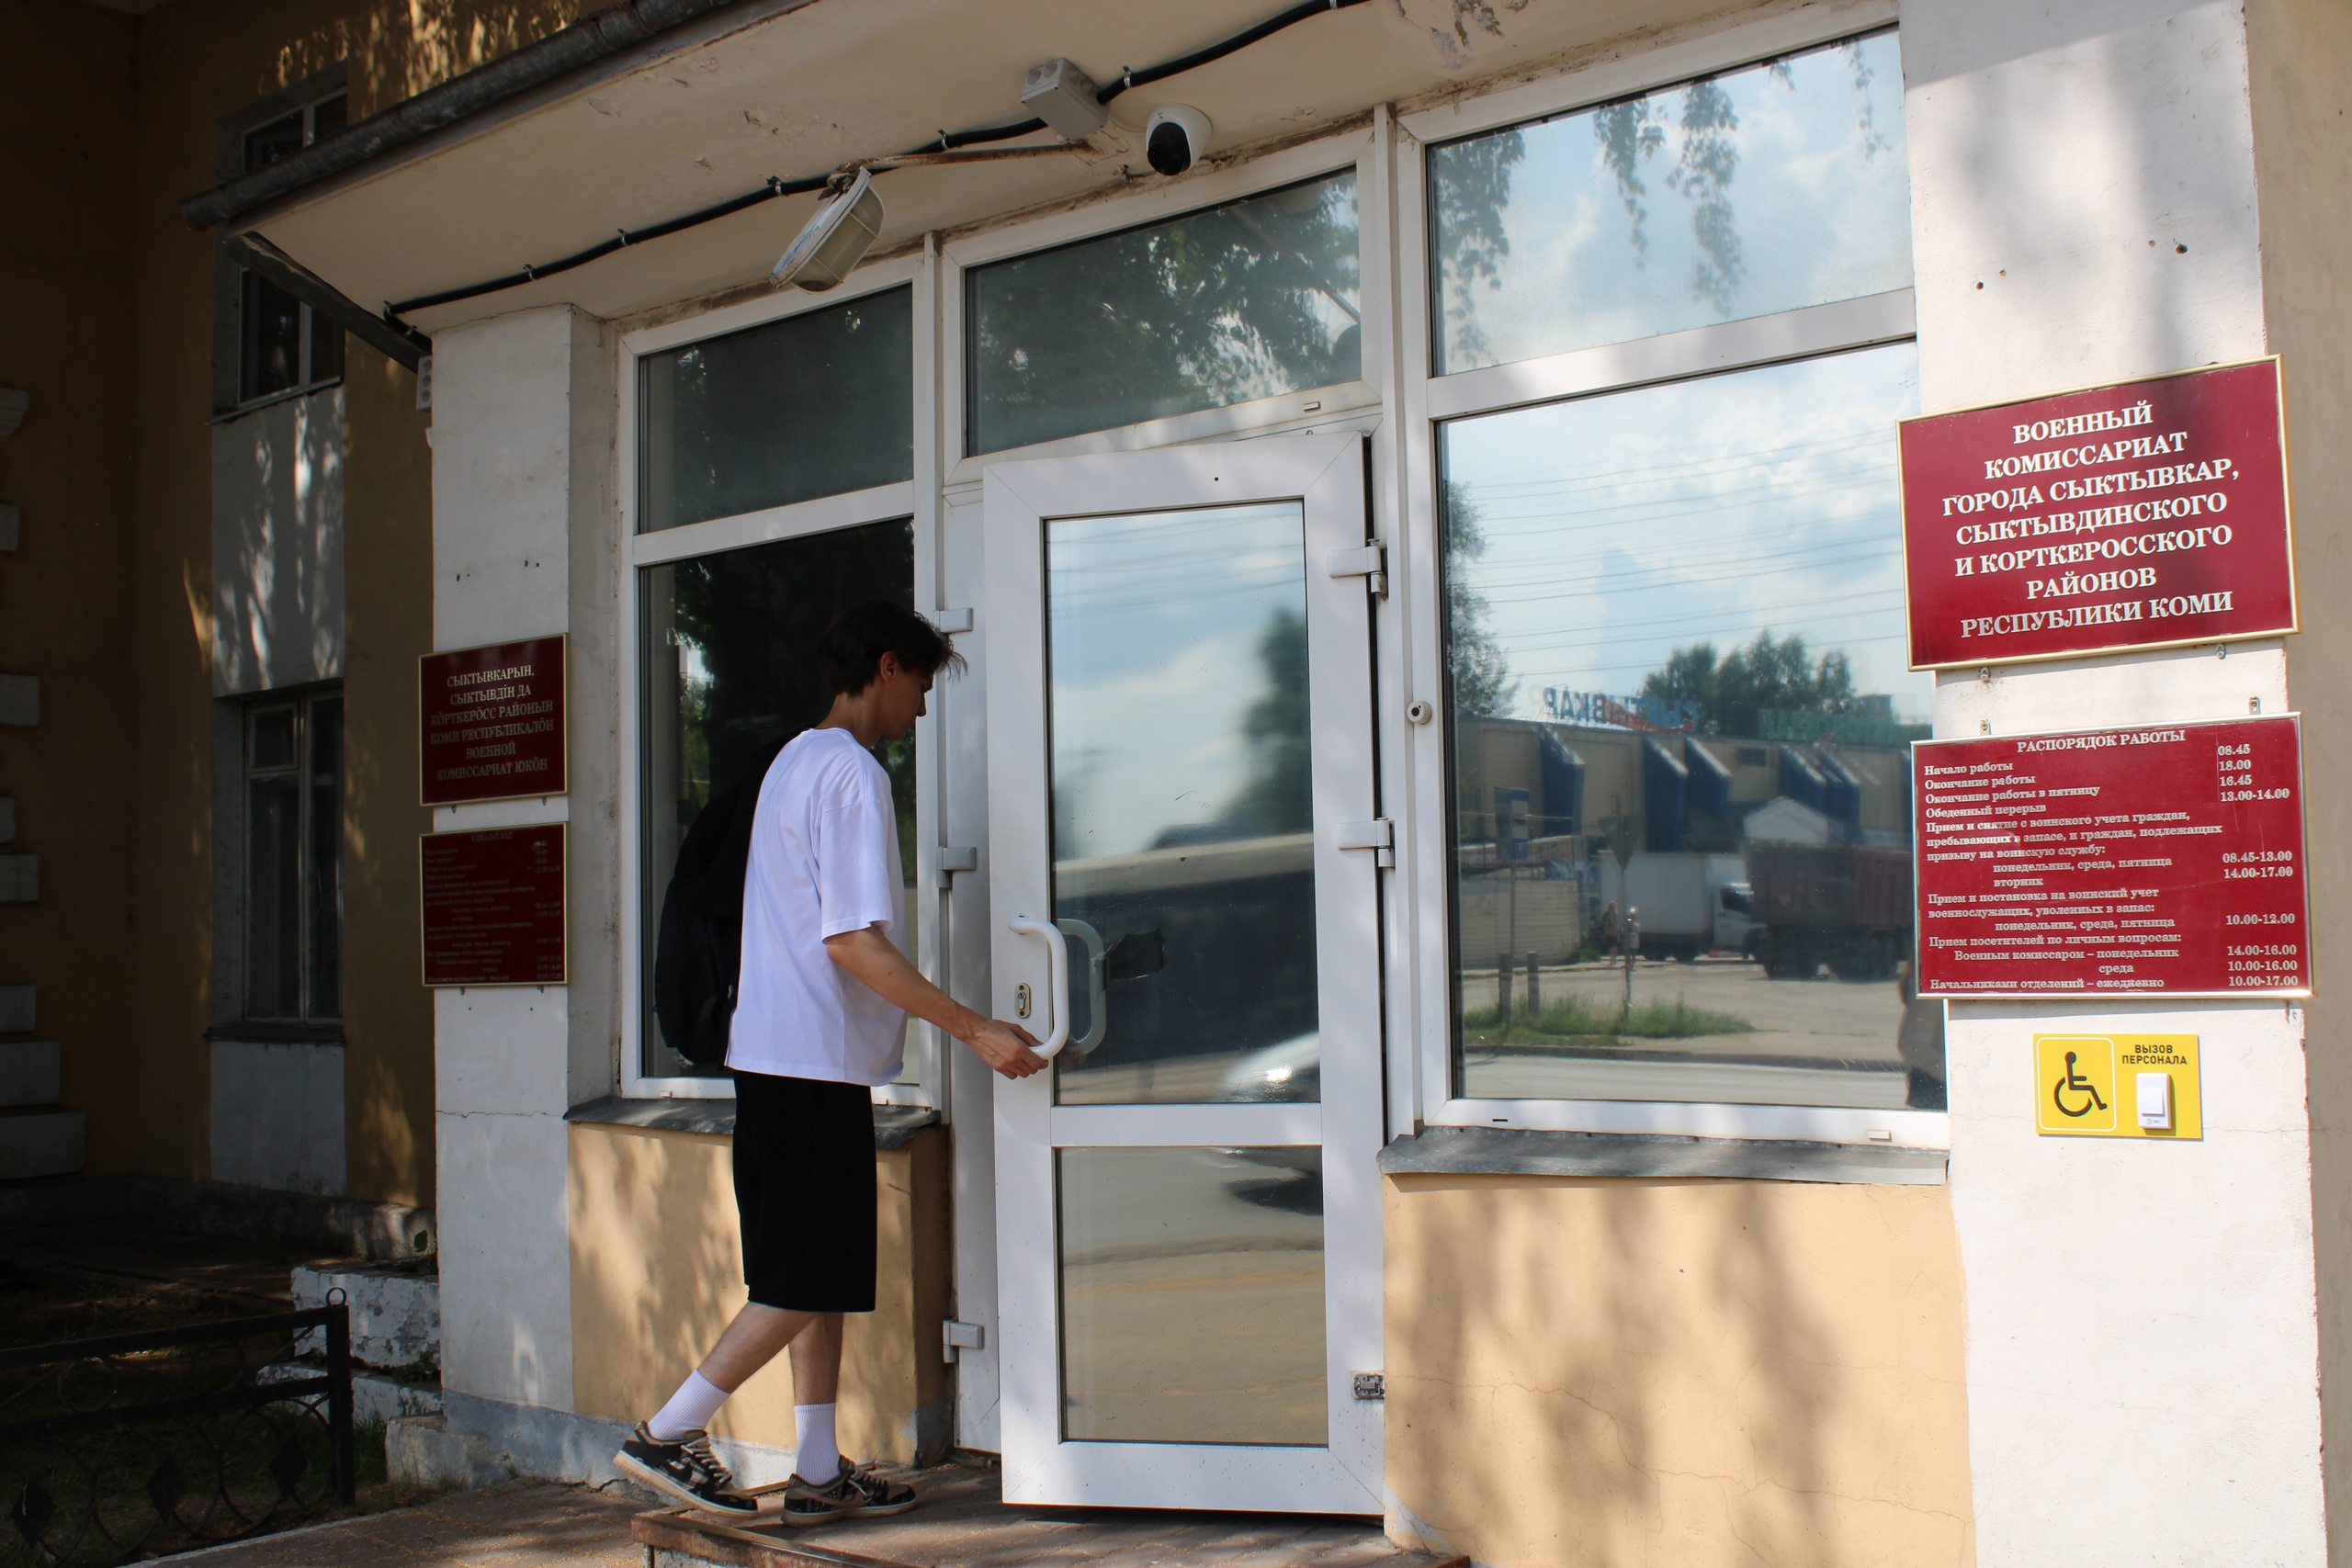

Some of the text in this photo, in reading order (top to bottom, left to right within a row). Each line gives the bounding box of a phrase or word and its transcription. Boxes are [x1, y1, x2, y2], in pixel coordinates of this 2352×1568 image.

[2012, 400, 2153, 444] ВОЕННЫЙ
[1984, 431, 2188, 479] КОМИССАРИАТ
[1941, 457, 2239, 516] ГОРОДА СЫКТЫВКАР,
[1956, 491, 2228, 546] СЫКТЫВДИНСКОГО
[1954, 525, 2233, 577] И КОРТКЕРОССКОГО
[2026, 567, 2157, 600] РАЙОНОВ
[1960, 591, 2234, 638] РЕСПУБЛИКИ КОМИ
[498, 700, 553, 718] РАЙОНЫН
[430, 732, 460, 746] КОМИ
[2017, 729, 2185, 752] РАСПОРЯДОК РАБОТЫ
[466, 739, 516, 760] ВОЕННОЙ
[2217, 743, 2250, 756] 08.45
[436, 761, 514, 781] КОМИССАРИАТ
[1924, 761, 2013, 775] Начало работы
[2218, 759, 2251, 771] 18.00
[1924, 774, 2035, 789] Окончание работы
[2219, 773, 2252, 786] 16.45
[1925, 786, 2100, 804] Окончание работы в пятницу
[2220, 787, 2290, 801] 13.00-14.00
[1925, 804, 2046, 818] Обеденный перерыв
[1925, 811, 2189, 834] Прием и снятие с воинского учета граждан,
[1926, 825, 2222, 848] пребывающих в запасе, и граждан, подлежащих
[1926, 843, 2105, 863] призыву на воинскую службу:
[2222, 850, 2292, 863] 08.45-13.00
[1992, 857, 2172, 873] понедельник, среда, пятница
[2223, 865, 2293, 878] 14.00-17.00
[1993, 877, 2043, 888] вторник
[1927, 887, 2159, 906] Прием и постановка на воинский учет
[1928, 904, 2154, 919] военнослужащих, уволенных в запас:
[2225, 912, 2295, 925] 10.00-12.00
[1994, 919, 2175, 931] понедельник, среда, пятница
[1928, 933, 2181, 949] Прием посетителей по личным вопросам:
[1953, 950, 2009, 960] Военным
[2011, 951, 2085, 961] комиссаром
[2096, 949, 2179, 959] понедельник
[2227, 943, 2297, 955] 14.00-16.00
[2098, 964, 2134, 975] среда
[2227, 959, 2298, 971] 10.00-16.00
[1929, 979, 2018, 989] Начальниками
[2019, 977, 2085, 989] отделений
[2096, 979, 2164, 988] ежедневно
[2228, 975, 2299, 987] 10.00-17.00
[2134, 1044, 2173, 1054] ВЫЗОВ
[2122, 1055, 2188, 1065] ПЕРСОНАЛА
